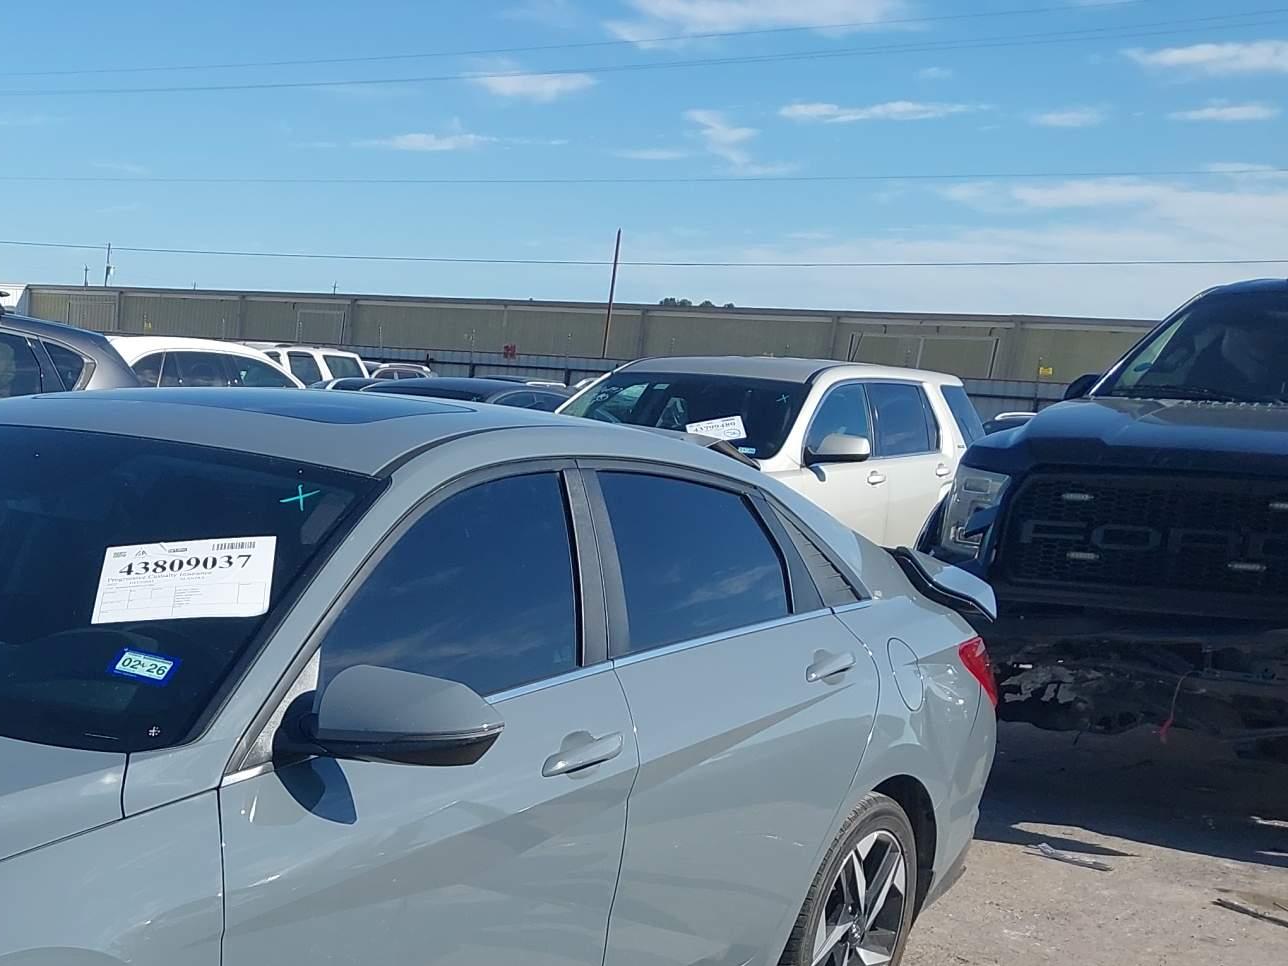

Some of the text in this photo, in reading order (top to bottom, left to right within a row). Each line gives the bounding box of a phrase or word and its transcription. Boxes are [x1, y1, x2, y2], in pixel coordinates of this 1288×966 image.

[118, 554, 253, 576] 43809037
[121, 657, 168, 676] 02 26
